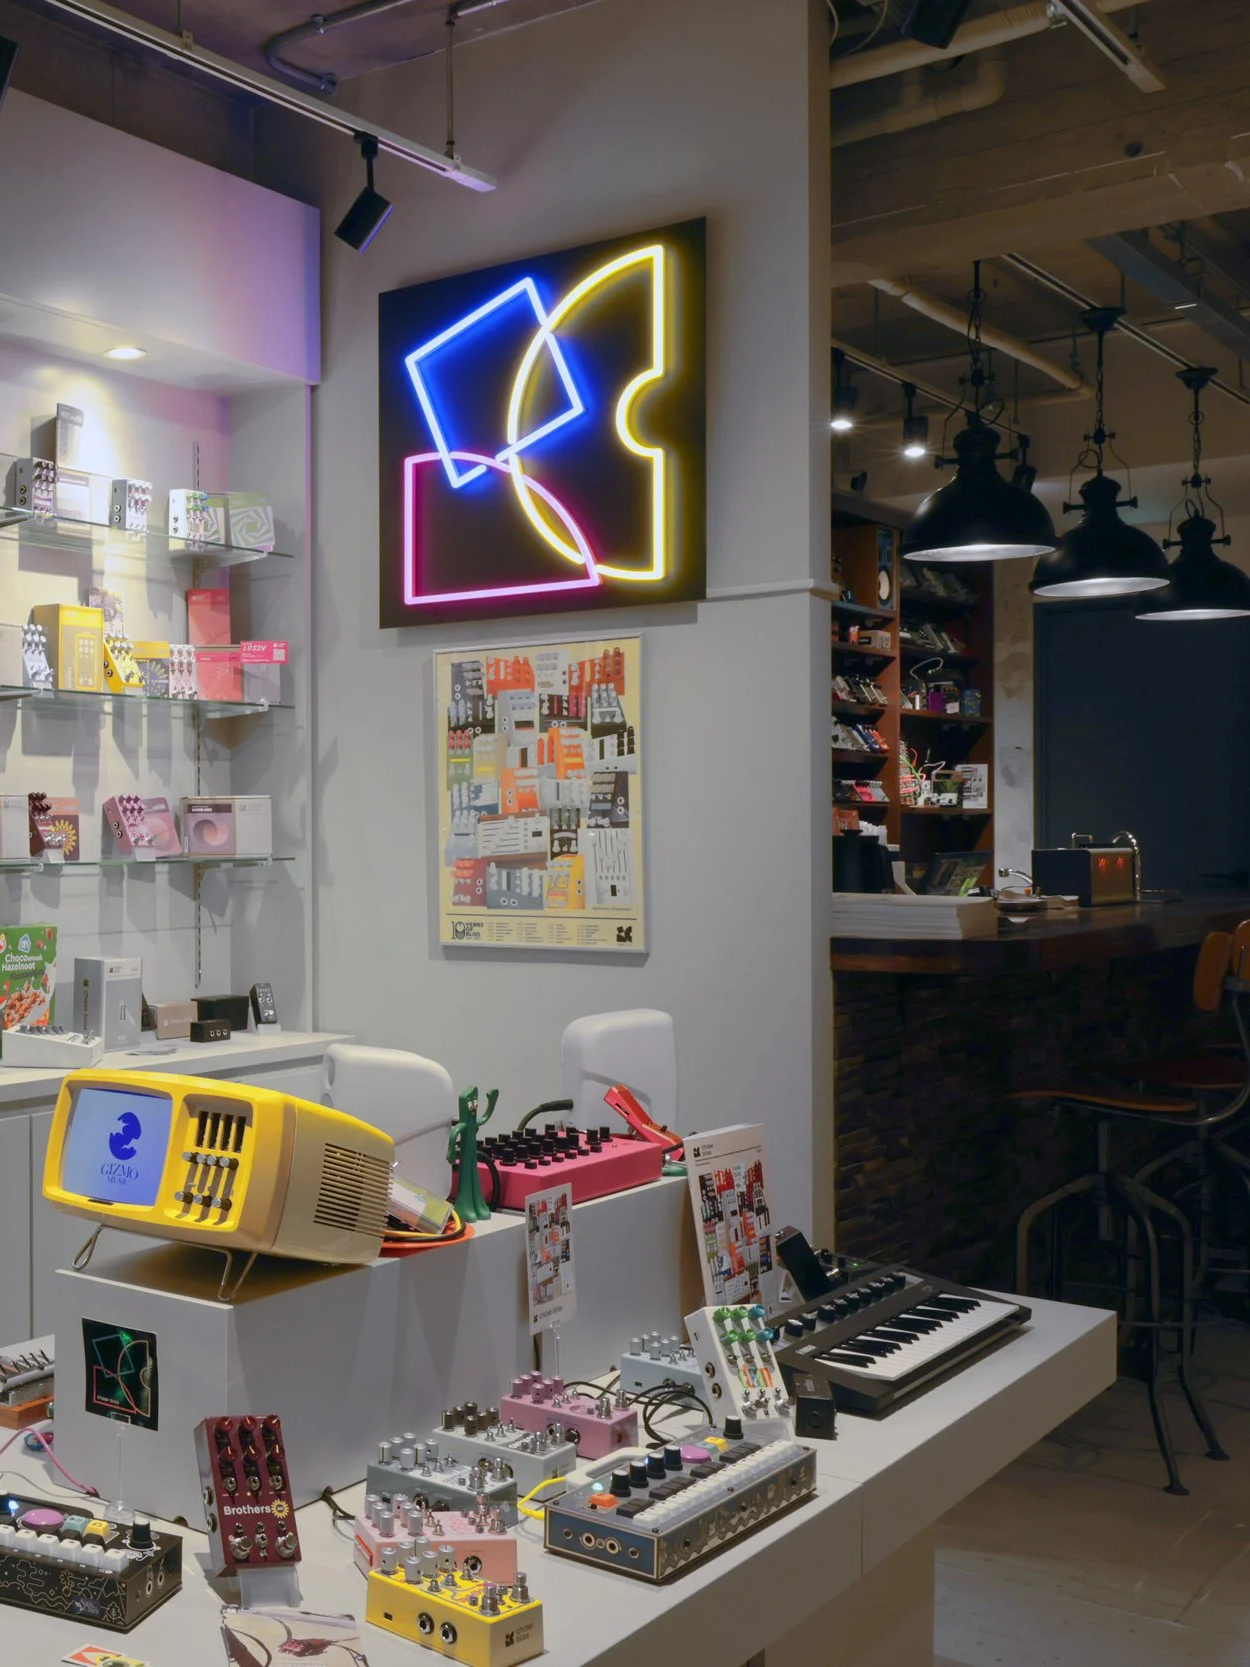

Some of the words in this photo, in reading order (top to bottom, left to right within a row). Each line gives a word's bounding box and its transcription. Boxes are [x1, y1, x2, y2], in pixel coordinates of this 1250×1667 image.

[1, 962, 36, 972] Hazelnoot
[100, 1162, 139, 1181] GIZMO
[223, 1504, 271, 1516] Brothers
